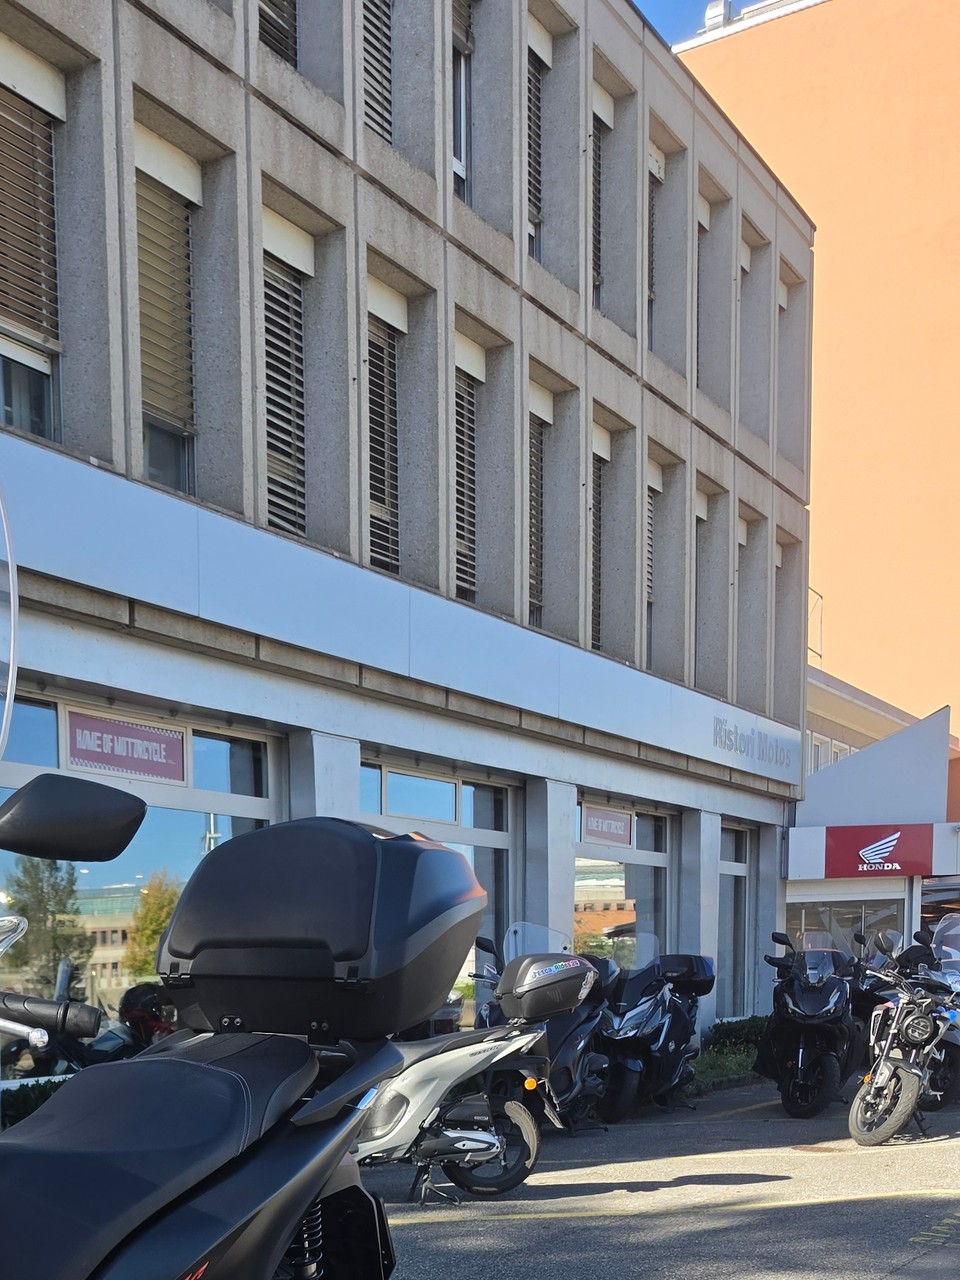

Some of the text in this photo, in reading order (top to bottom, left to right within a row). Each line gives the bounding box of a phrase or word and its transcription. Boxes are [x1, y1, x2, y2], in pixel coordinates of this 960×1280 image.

[76, 728, 102, 752] HOME
[713, 715, 755, 758] Ristori
[857, 862, 902, 871] HONDA
